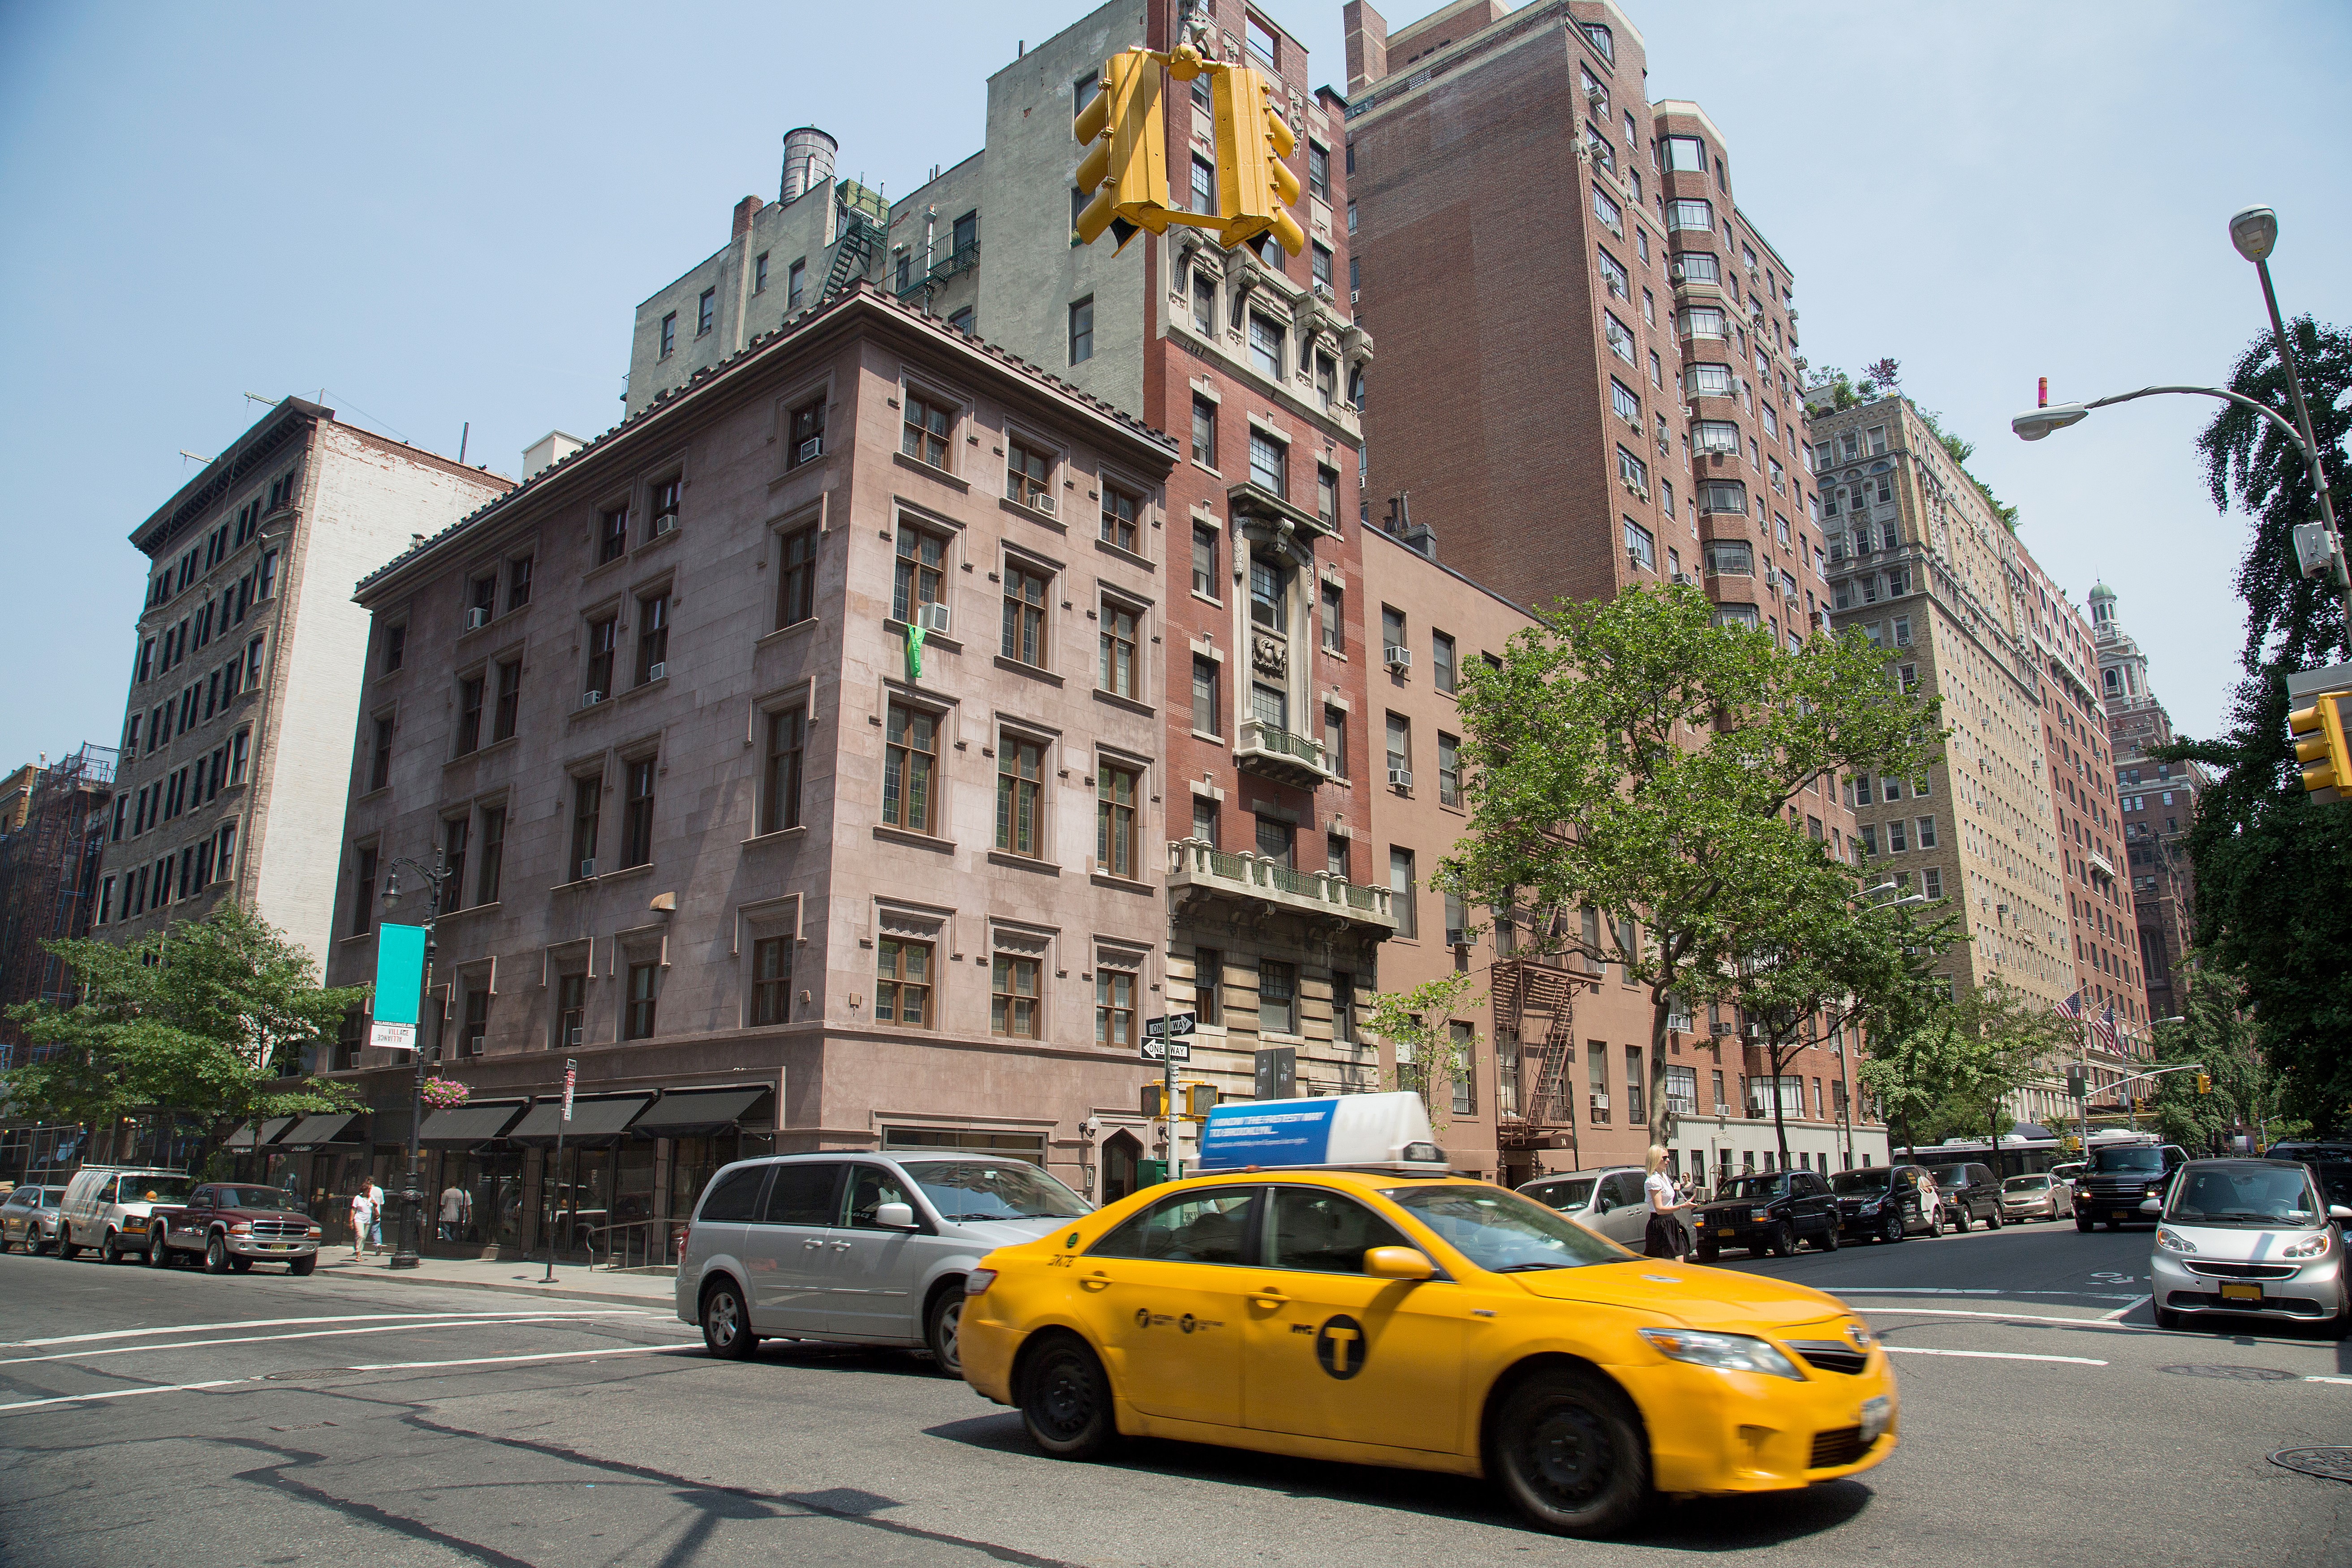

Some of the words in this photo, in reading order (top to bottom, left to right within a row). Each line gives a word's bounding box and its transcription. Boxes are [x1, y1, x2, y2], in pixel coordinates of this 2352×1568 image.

[1173, 1020, 1188, 1030] WAY
[1149, 1044, 1163, 1053] ONE
[1170, 1046, 1184, 1055] WAY
[1324, 1327, 1360, 1372] T
